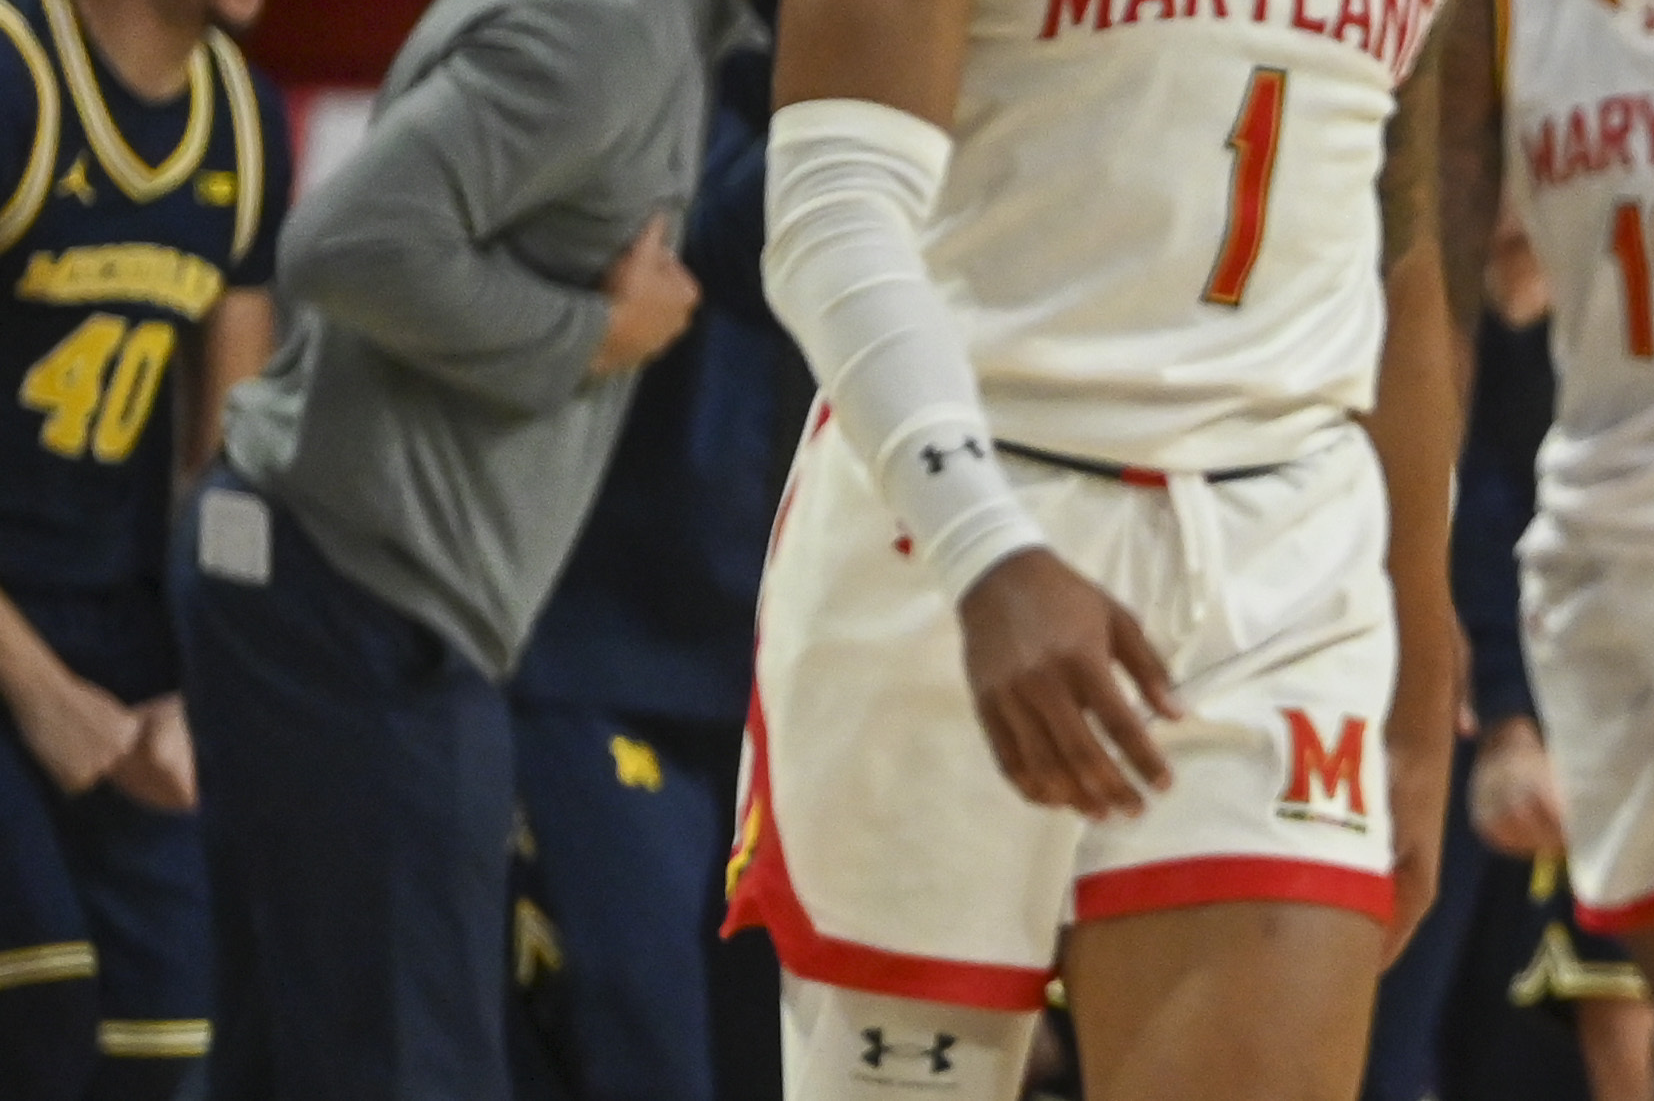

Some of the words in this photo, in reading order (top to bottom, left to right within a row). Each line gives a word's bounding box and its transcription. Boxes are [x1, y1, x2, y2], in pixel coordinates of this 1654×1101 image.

[1200, 65, 1287, 310] 1
[18, 311, 177, 465] 40
[1277, 707, 1370, 817] M
